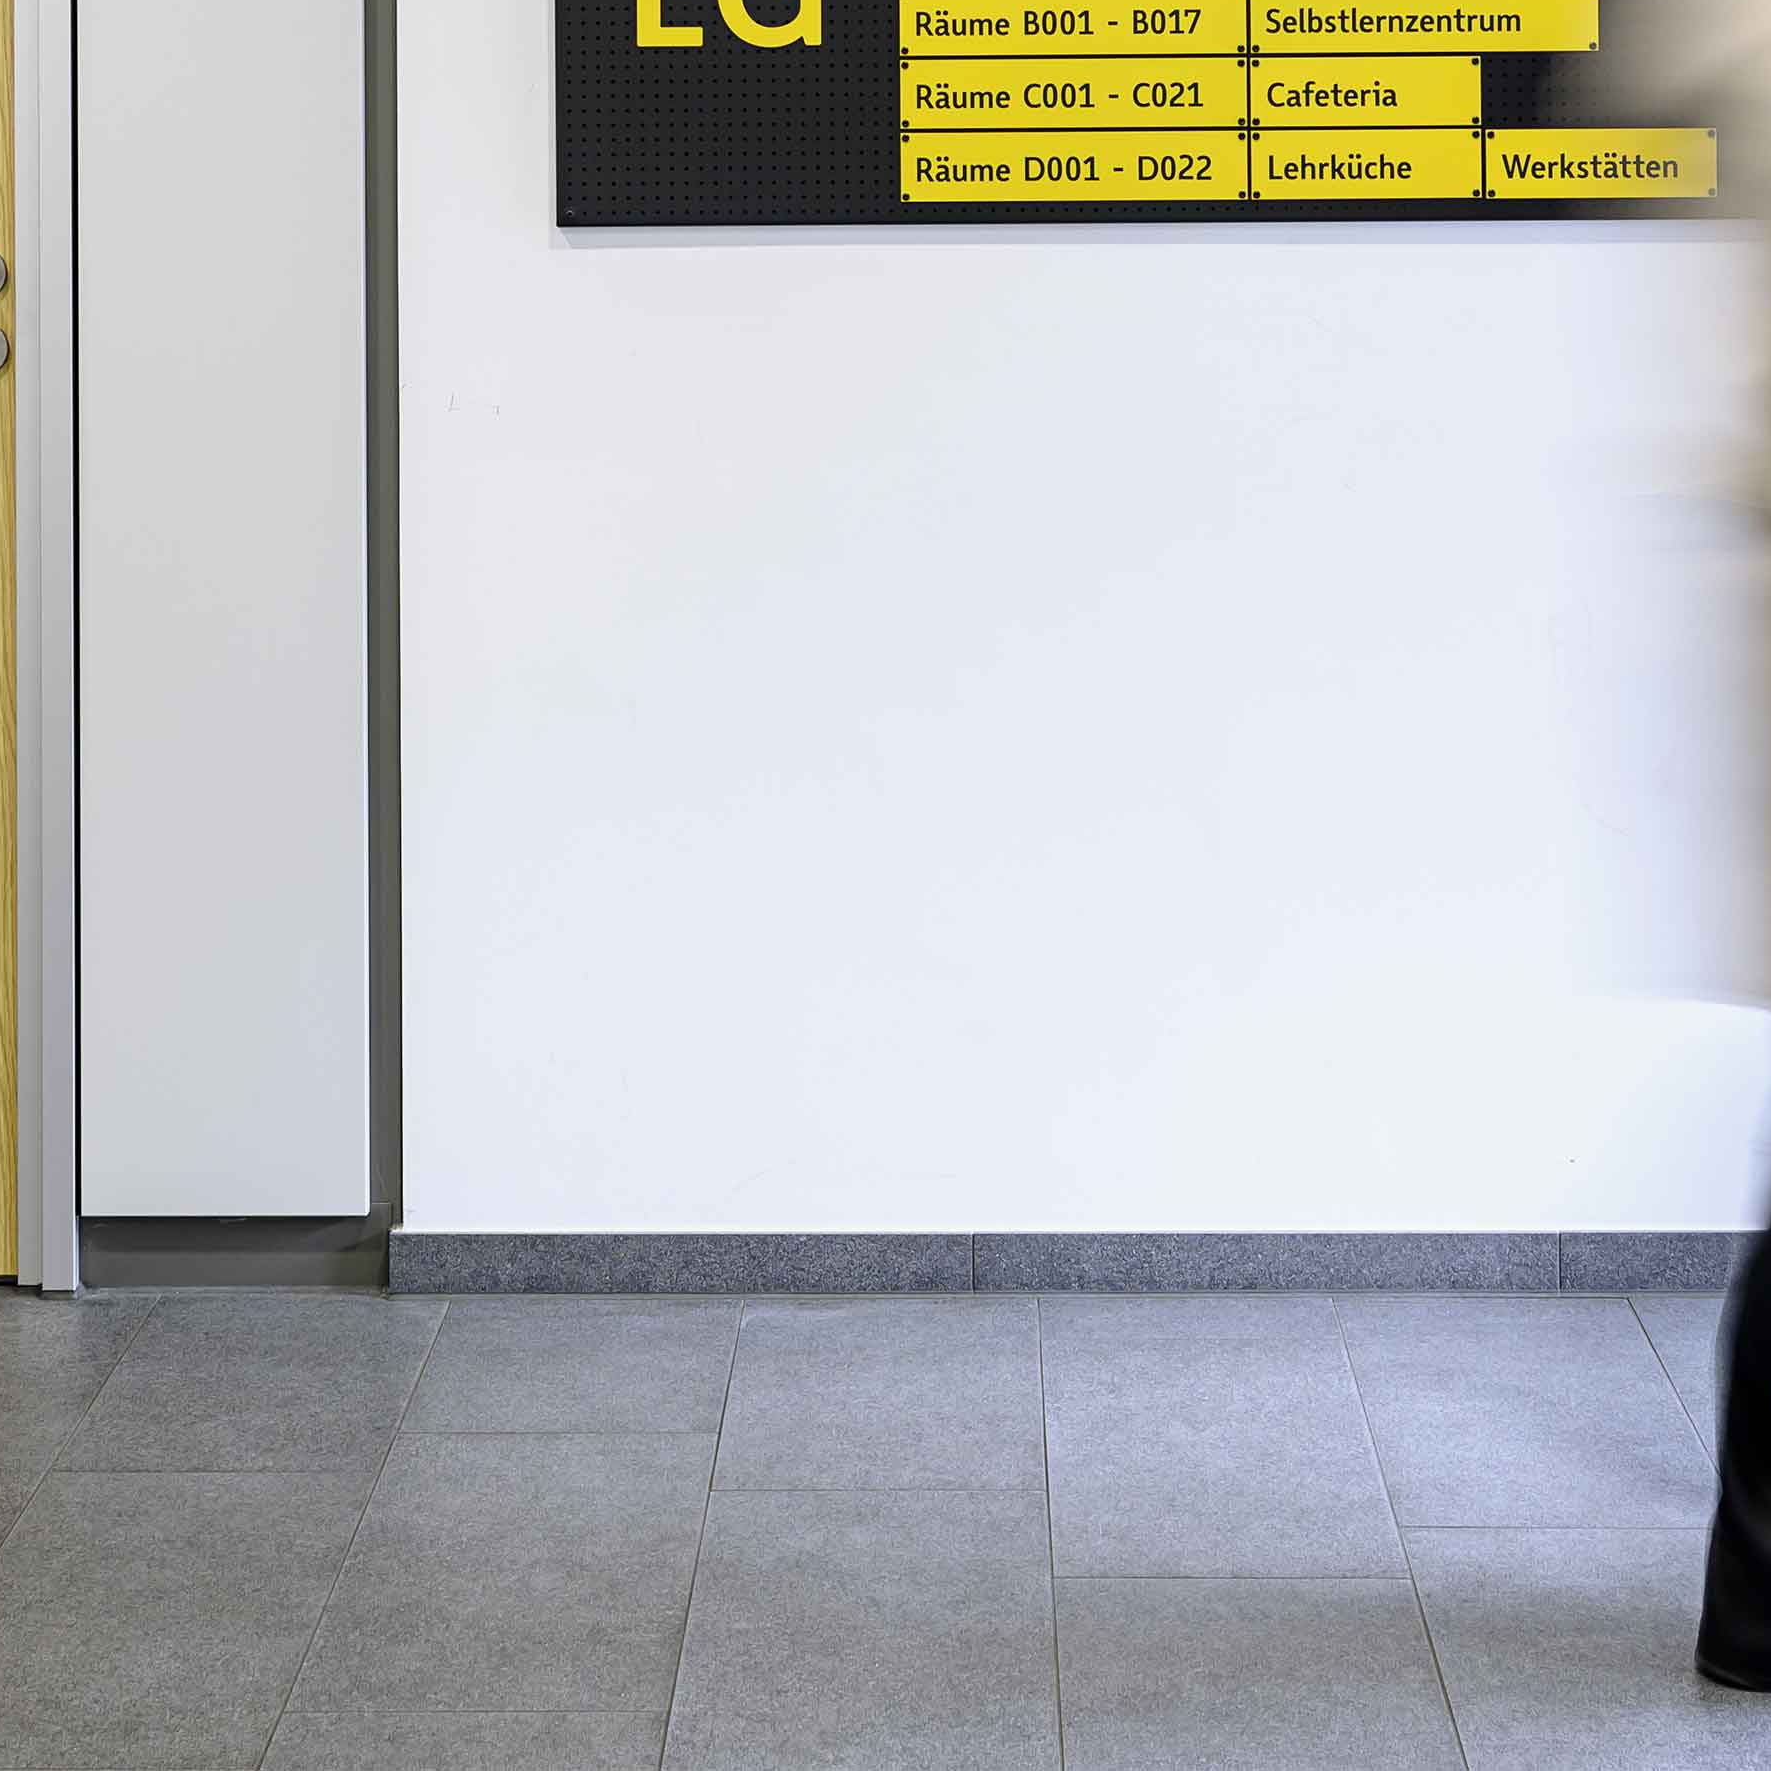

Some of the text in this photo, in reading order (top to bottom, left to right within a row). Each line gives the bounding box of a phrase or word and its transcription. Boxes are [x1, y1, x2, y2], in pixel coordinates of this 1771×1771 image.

[915, 9, 1010, 37] Räume
[1024, 9, 1095, 36] B001
[1132, 8, 1202, 35] B017
[1265, 7, 1521, 34] Selbstlernzentrum
[916, 82, 1011, 110] Räume
[1023, 82, 1096, 109] C001
[1132, 81, 1204, 108] C021
[1267, 80, 1398, 108] Cafeteria
[916, 155, 1011, 183] Räume
[1024, 155, 1100, 182] D001
[1138, 154, 1213, 181] D022
[1268, 153, 1412, 181] Lehrküche
[1501, 152, 1678, 179] Werkstätten
